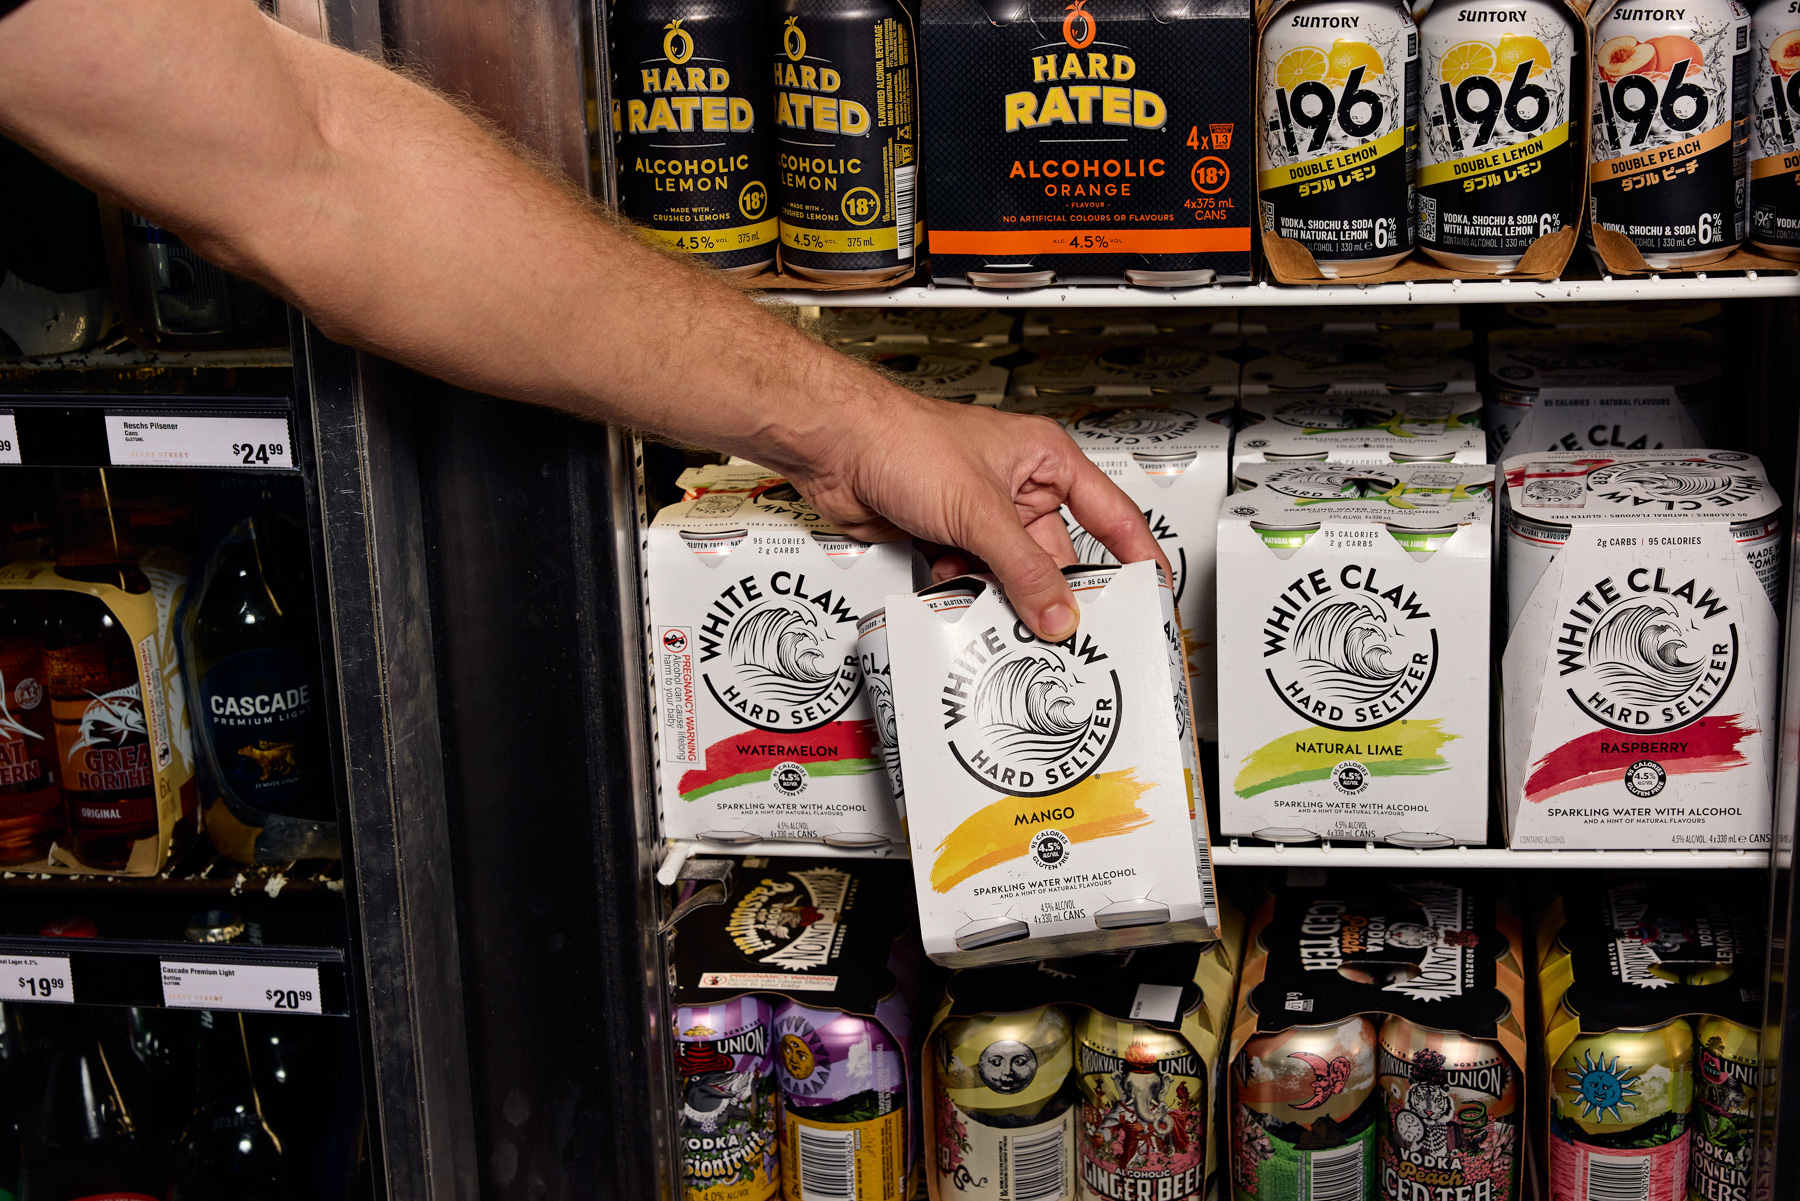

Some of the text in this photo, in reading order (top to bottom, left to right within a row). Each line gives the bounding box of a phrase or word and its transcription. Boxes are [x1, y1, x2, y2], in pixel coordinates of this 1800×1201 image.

[874, 24, 887, 127] FLAVOURED ALCOHOL BEVERAGE
[1032, 53, 1136, 83] HARD
[641, 65, 731, 93] HARD
[774, 63, 840, 93] HARD
[628, 96, 755, 134] RATED
[1005, 85, 1168, 133] RATED
[635, 154, 749, 175] ALCOHOLIC
[1289, 145, 1378, 181] DOUBLE LEMON
[1453, 140, 1544, 176] DOUBLE LEMON
[1611, 139, 1702, 175] DOUBLE PEACH
[1009, 158, 1166, 178] ALCOHOLIC
[654, 176, 728, 192] LEMON
[781, 172, 838, 191] LEMON
[1044, 183, 1131, 197] ORANGE
[1183, 197, 1235, 209] 4x375 mL
[653, 212, 731, 222] CRUSHED LEMONS
[1019, 215, 1067, 223] ARTIFICIAL
[1069, 214, 1111, 222] COLOURS
[1113, 214, 1127, 222] OR
[1129, 214, 1174, 222] FLAVOURS
[1194, 210, 1227, 220] CANS
[1280, 216, 1373, 230] VODKA, SHOCHU & SODA
[1443, 212, 1538, 226] VODKA, SHOCHU & SODA
[1280, 227, 1369, 241] WITH NATURAL LEMON
[1443, 223, 1533, 236] WITH NATURAL LEMON
[1629, 224, 1663, 236] SHOCHU
[1664, 225, 1673, 236] &
[1674, 224, 1697, 236] SODA
[737, 233, 751, 244] 375
[1069, 235, 1109, 249] 4.5%
[123, 421, 179, 430] Reschs Pilsener
[753, 537, 806, 545] 95 CALORIES
[1609, 537, 1637, 546] CARBS
[1648, 537, 1660, 546] 95
[1661, 536, 1702, 545] CALORIES
[698, 570, 859, 663] WHITE CLAW
[1264, 567, 1332, 658] WHITE
[1340, 564, 1431, 622] CLAW
[1557, 577, 1621, 676] WHITE
[1627, 567, 1729, 620] CLAW
[941, 626, 1007, 730] WHITE
[1587, 642, 1729, 725] HARD SELTZER
[722, 653, 859, 725] HARD SELTZER
[1285, 652, 1429, 723] HARD SELTZER
[211, 684, 310, 716] CASCADE
[682, 654, 697, 762] PREGNANCY WARNING
[213, 715, 273, 726] PREMIUM
[736, 744, 838, 757] WATERMELON
[970, 697, 1113, 788] HARD SELTZER
[1296, 742, 1403, 756] NATURAL LIME
[1600, 742, 1689, 754] RASPBERRY
[81, 806, 121, 819] ORIGINAL
[825, 804, 867, 812] ALCOHOL
[1547, 807, 1742, 817] SPARKLING WATER WITH ALCOHOL
[1014, 807, 1075, 827] MANGO
[797, 830, 818, 838] CANS
[1749, 833, 1771, 843] CANS
[973, 868, 1137, 897] SPARKLING WATER WITH ALCOHOL
[1063, 909, 1086, 921] CANS
[162, 966, 235, 977] Cascade Premium Light
[717, 1026, 765, 1056] UNION
[1448, 1063, 1500, 1097] UNION
[1400, 1149, 1463, 1170] VODKA
[1114, 1167, 1171, 1178] ALCOHOLIC
[1400, 1164, 1464, 1186] Peach
